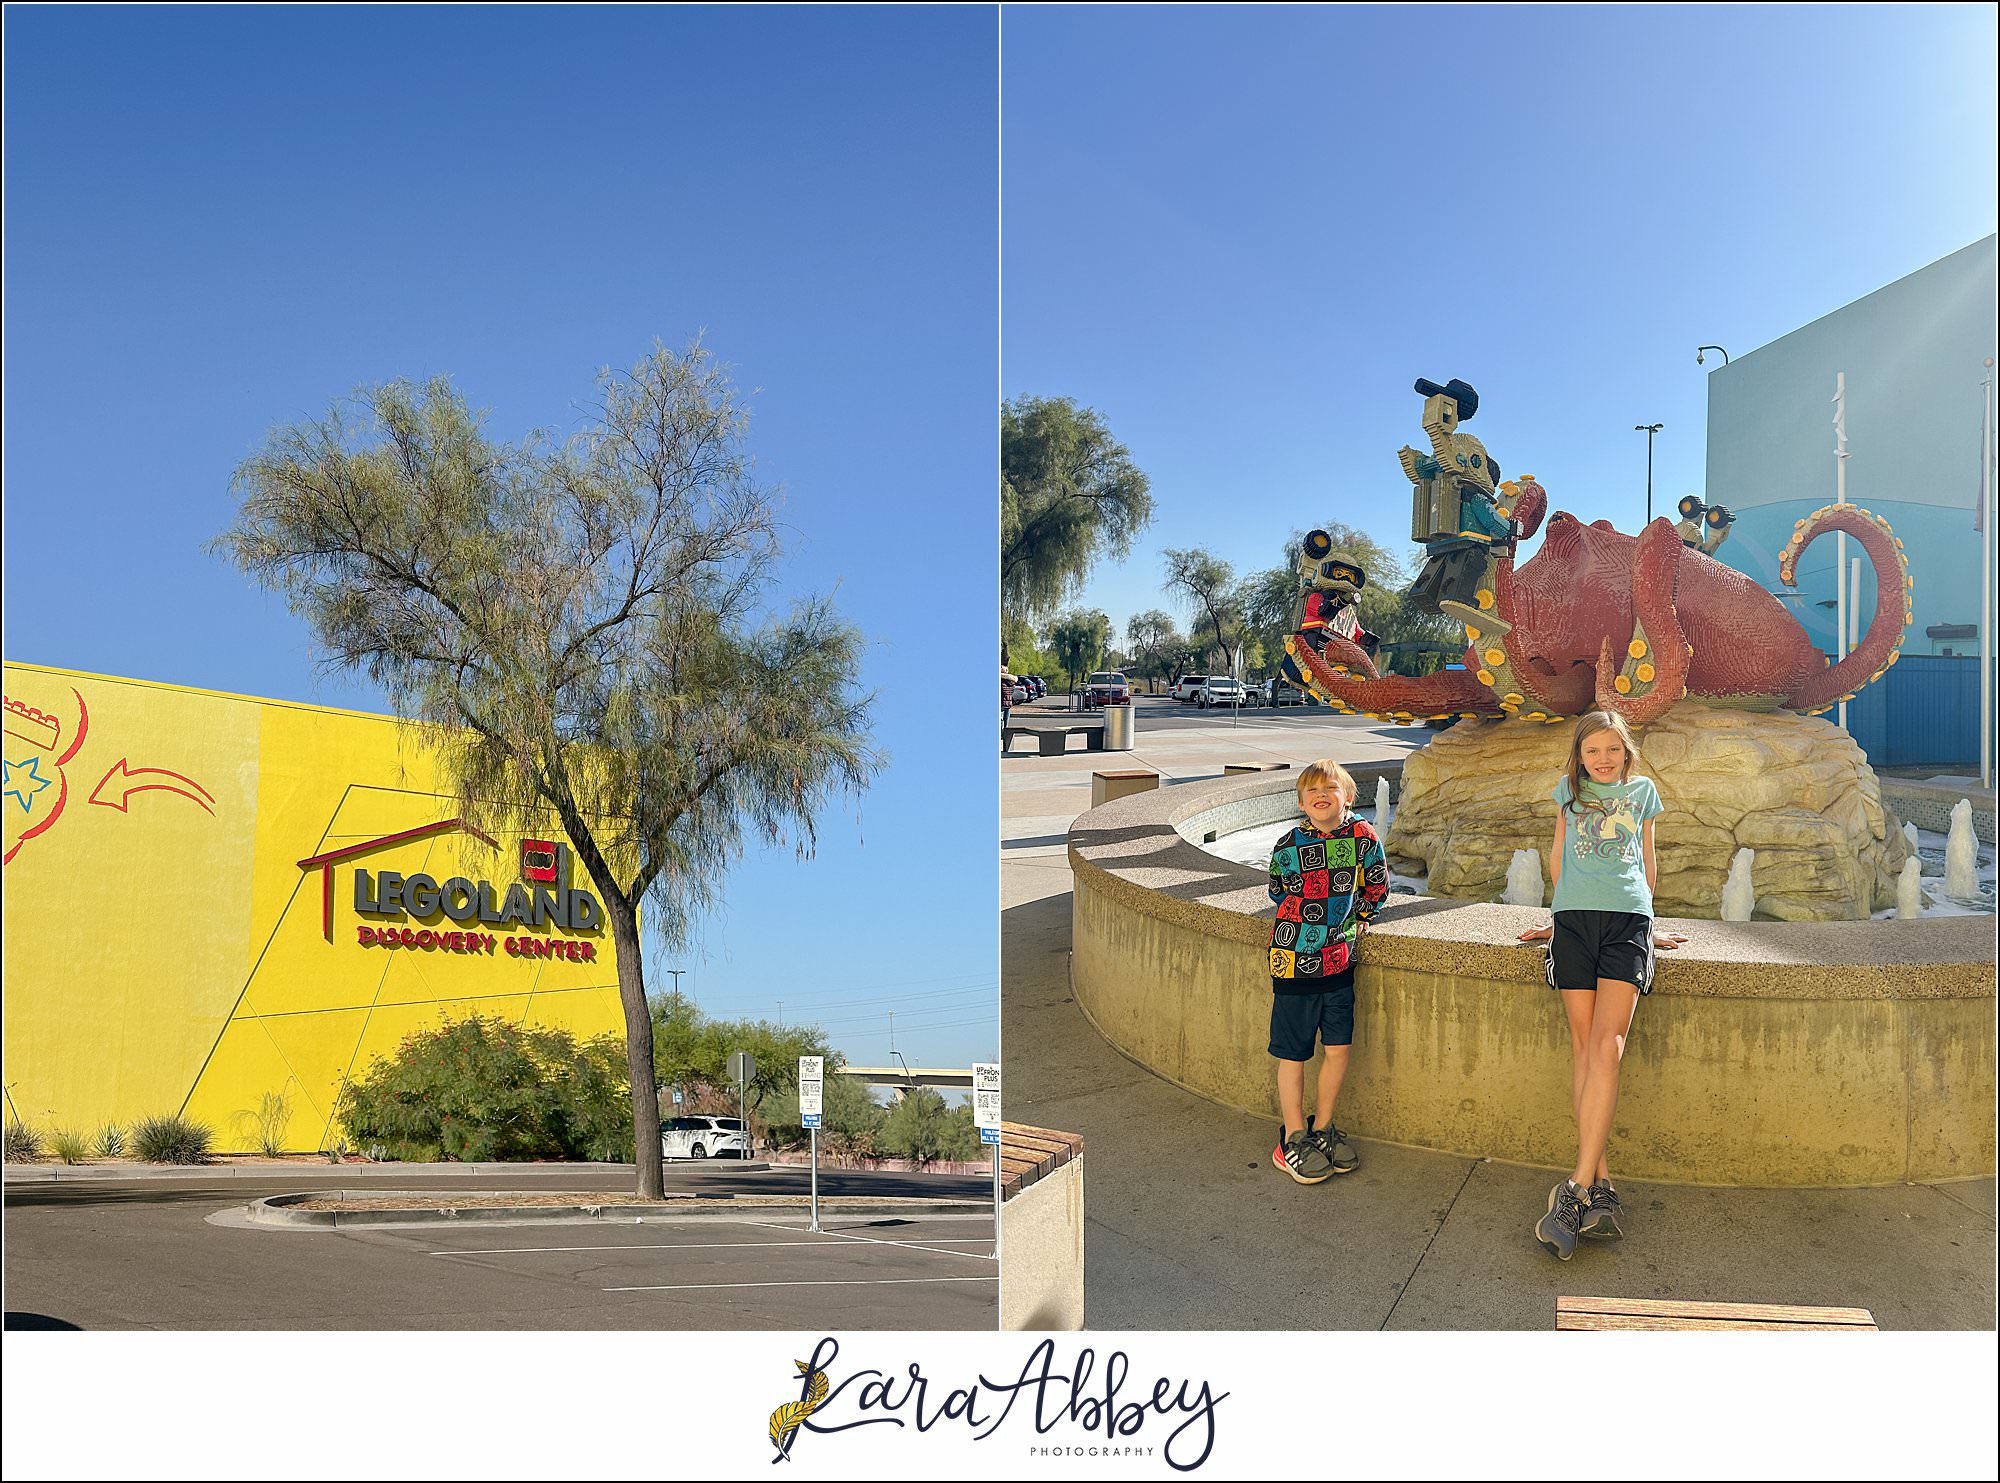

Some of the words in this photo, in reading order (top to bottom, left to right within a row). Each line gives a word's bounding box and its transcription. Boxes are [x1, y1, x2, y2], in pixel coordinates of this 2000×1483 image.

[354, 844, 599, 931] LEGOLAND
[357, 926, 496, 951] DISCOVERY
[504, 936, 596, 959] CENTER
